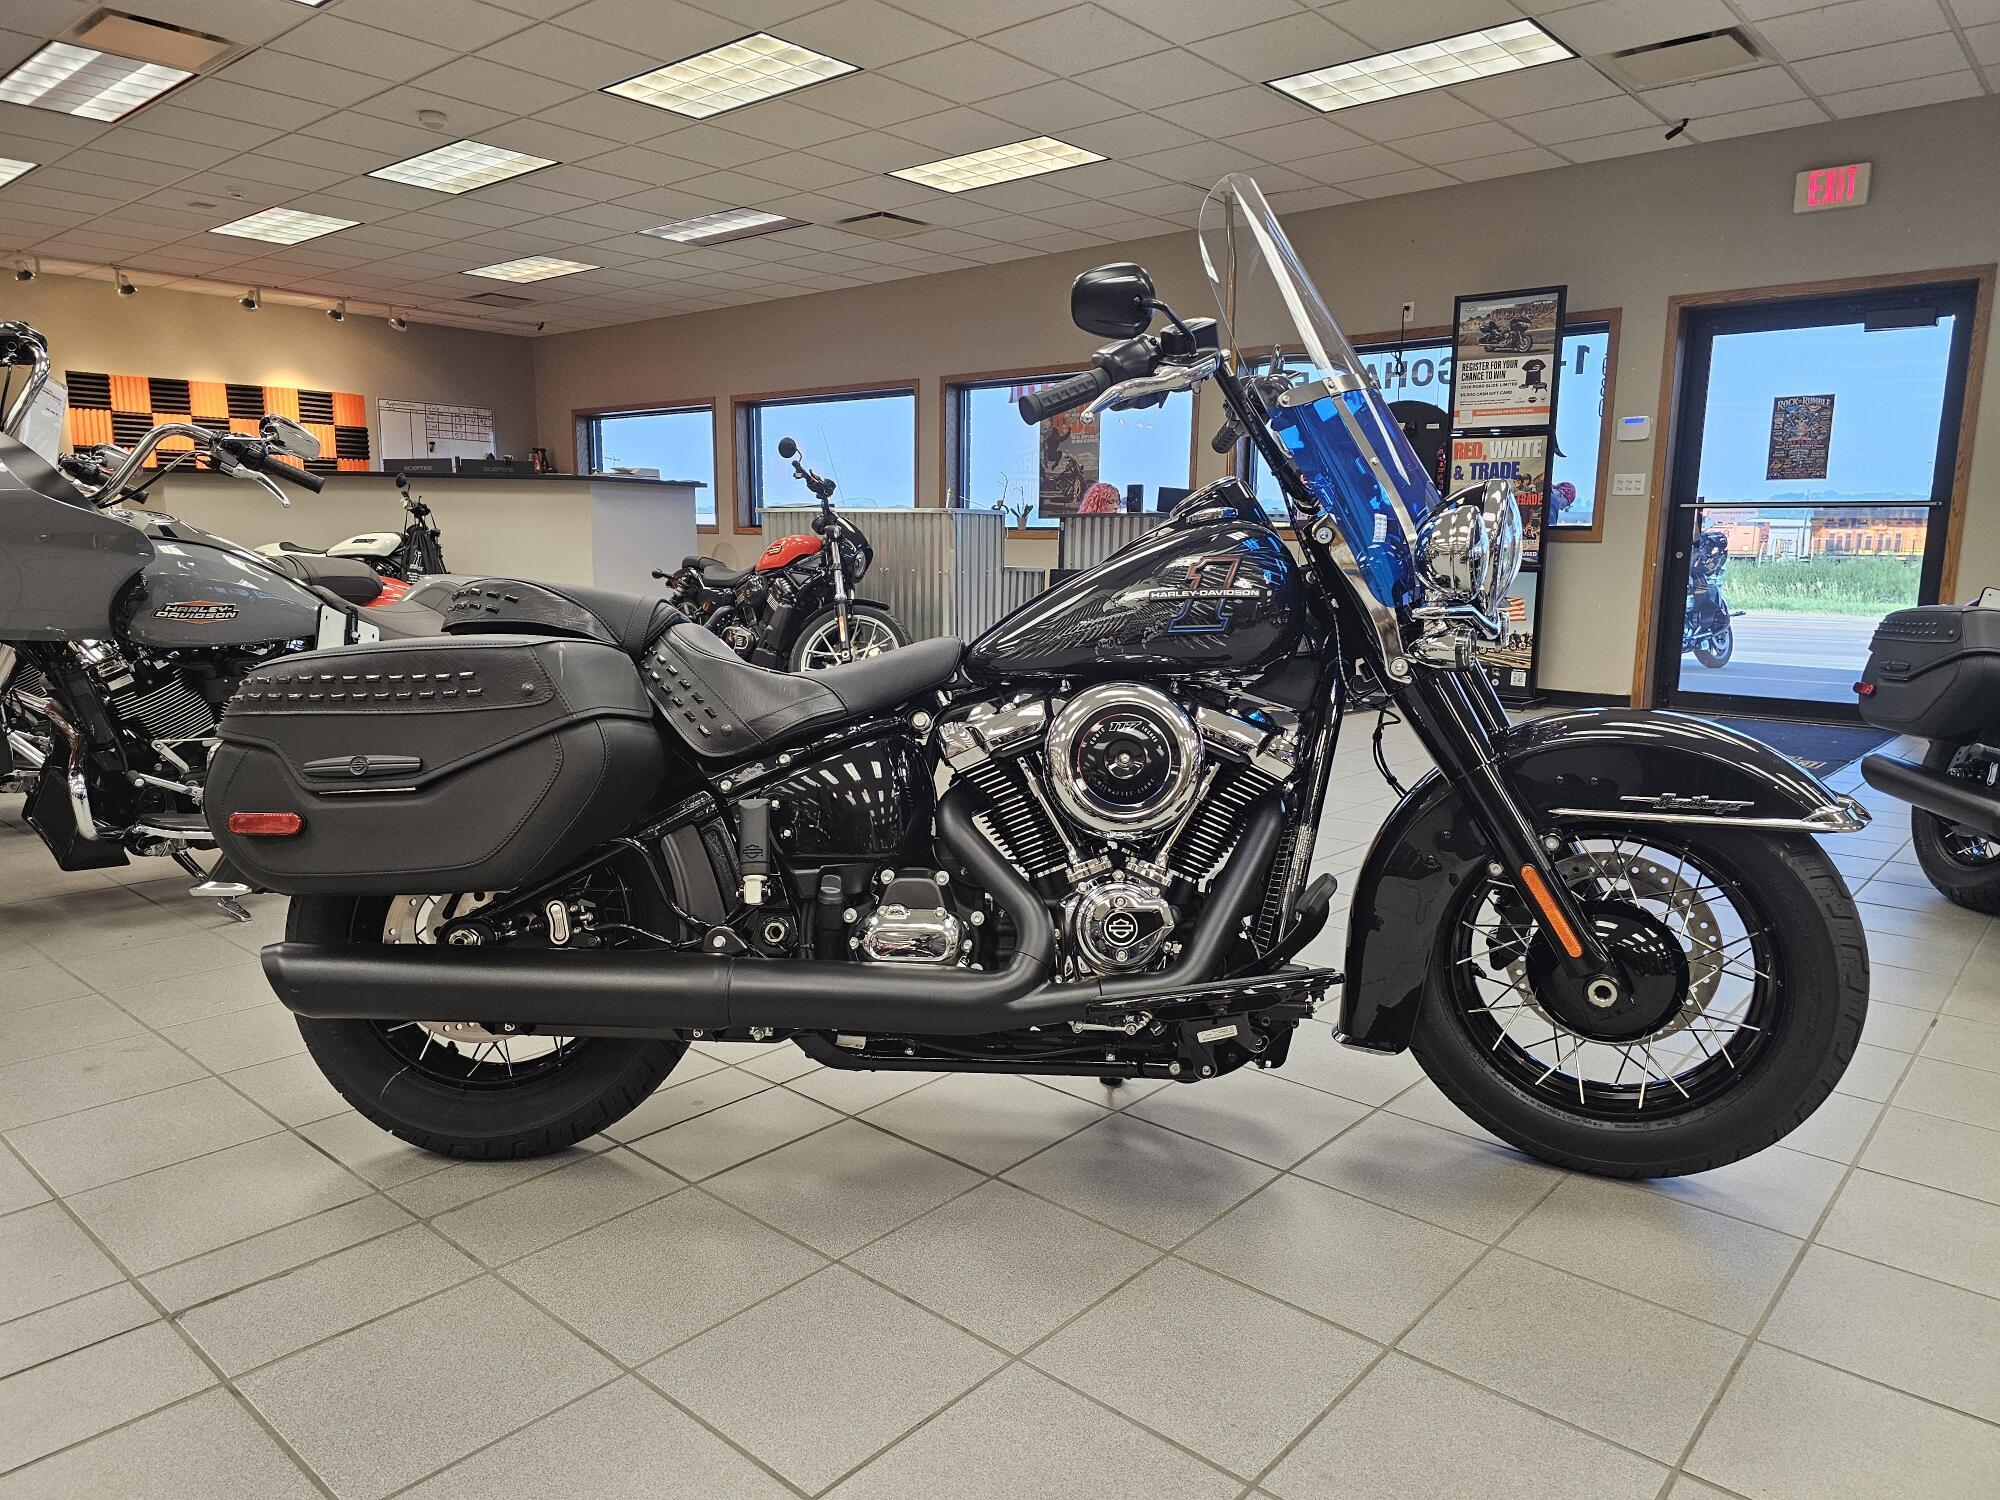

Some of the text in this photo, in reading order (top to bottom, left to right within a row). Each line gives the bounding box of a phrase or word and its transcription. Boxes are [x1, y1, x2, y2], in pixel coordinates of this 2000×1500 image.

[1808, 167, 1858, 207] EXIT
[1462, 360, 1519, 372] REGISTER FOR YOUR
[1461, 370, 1506, 381] CHANCE TO WIN
[1777, 396, 1832, 411] ROCK RUMBLE
[1454, 439, 1543, 461] RED, WHITE
[1453, 461, 1521, 480] & TRADE
[1517, 493, 1543, 506] TRADE
[1151, 589, 1260, 599] HARLEY-DAVIDSON
[155, 611, 237, 619] DAVIDSON
[164, 605, 233, 613] HARLEY-
[1109, 720, 1143, 732] 117
